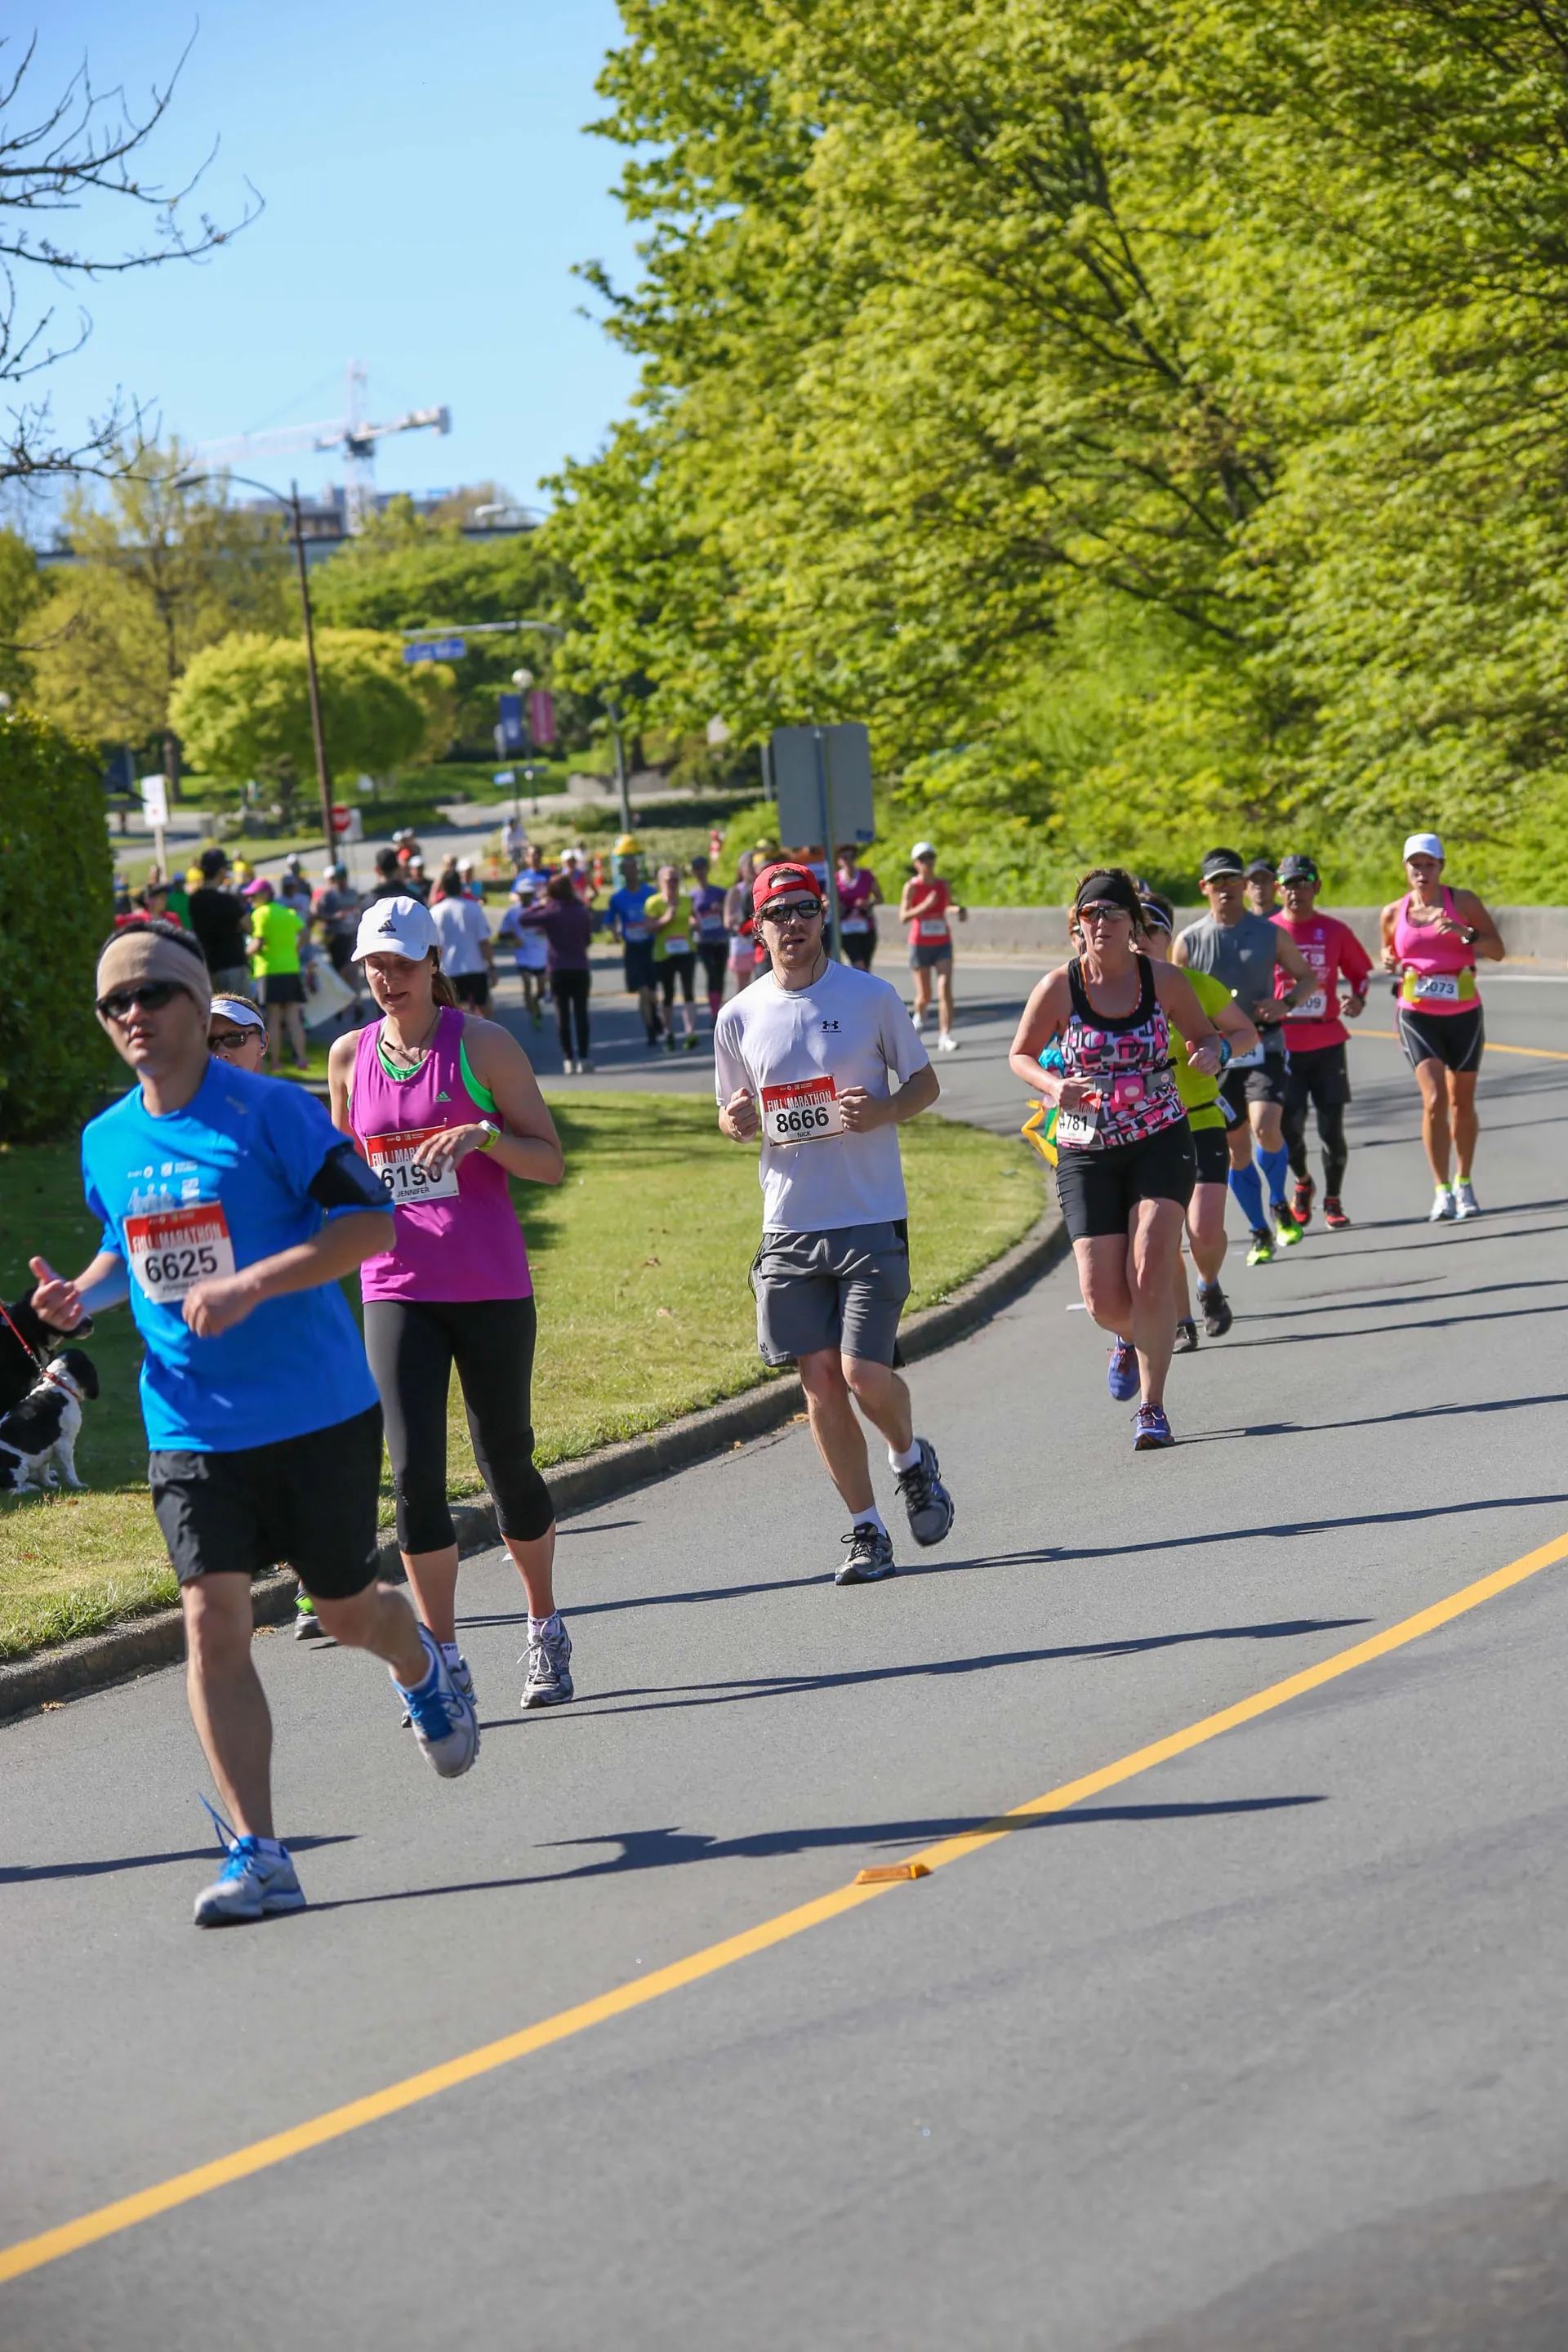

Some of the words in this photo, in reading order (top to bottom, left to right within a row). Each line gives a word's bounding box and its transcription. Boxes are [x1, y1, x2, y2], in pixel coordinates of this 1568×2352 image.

[766, 1098, 784, 1112] FULL
[786, 1090, 831, 1110] MARATHON
[776, 1107, 829, 1133] 8666
[372, 1151, 390, 1167] FULL
[397, 1187, 430, 1198] JENNIFER
[158, 1223, 223, 1248] MARATHON
[145, 1245, 218, 1283] 6625
